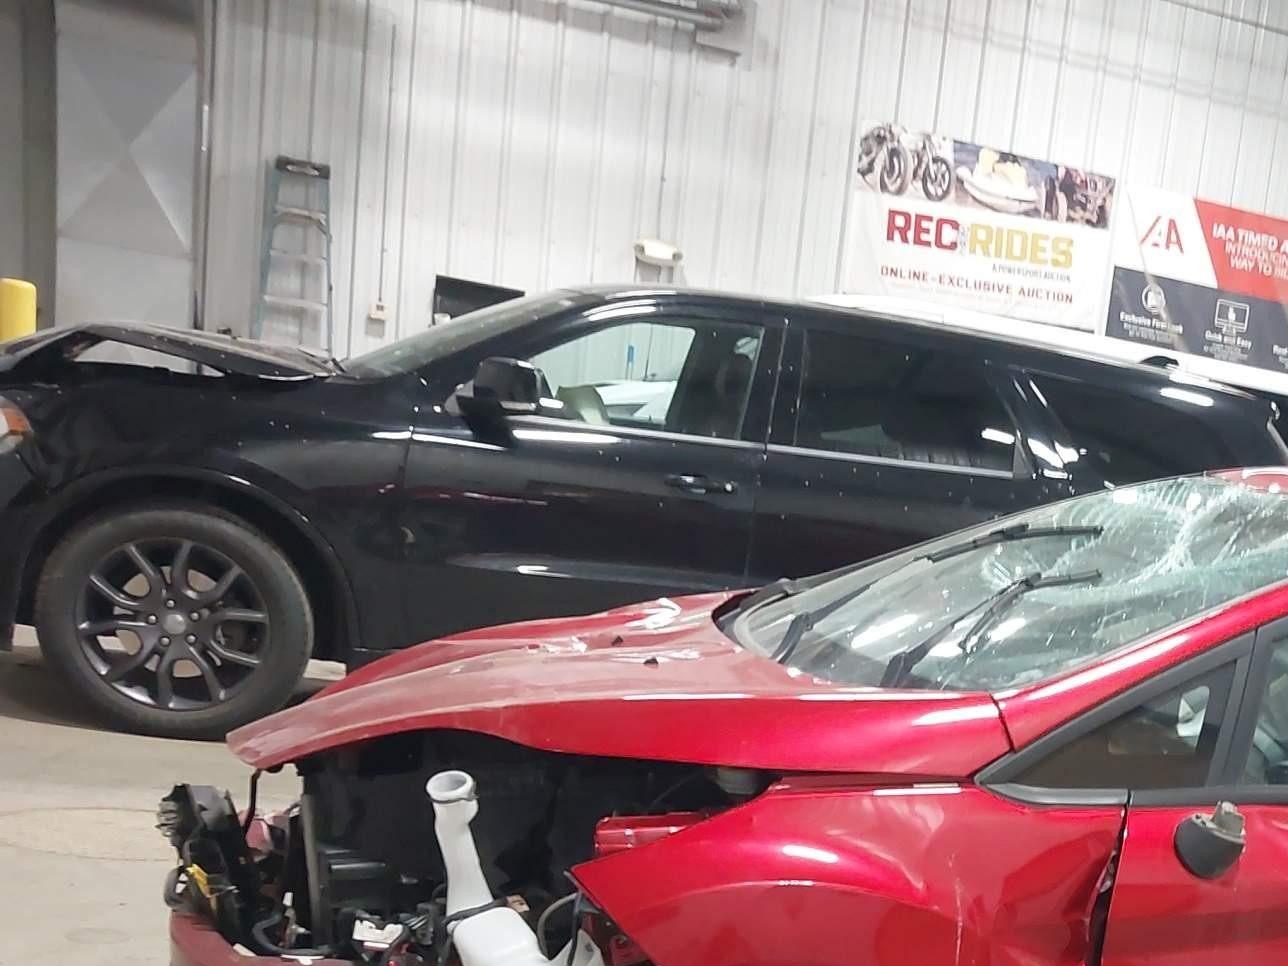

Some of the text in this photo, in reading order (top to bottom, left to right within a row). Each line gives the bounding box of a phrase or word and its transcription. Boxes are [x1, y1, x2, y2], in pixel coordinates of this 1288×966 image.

[886, 207, 960, 251] REC
[968, 222, 1074, 269] RIDES
[1212, 222, 1235, 242] IAA
[1237, 228, 1278, 253] TIMED
[1230, 254, 1256, 272] WAY
[1258, 261, 1273, 277] TO
[1018, 286, 1073, 304] AUCTION
